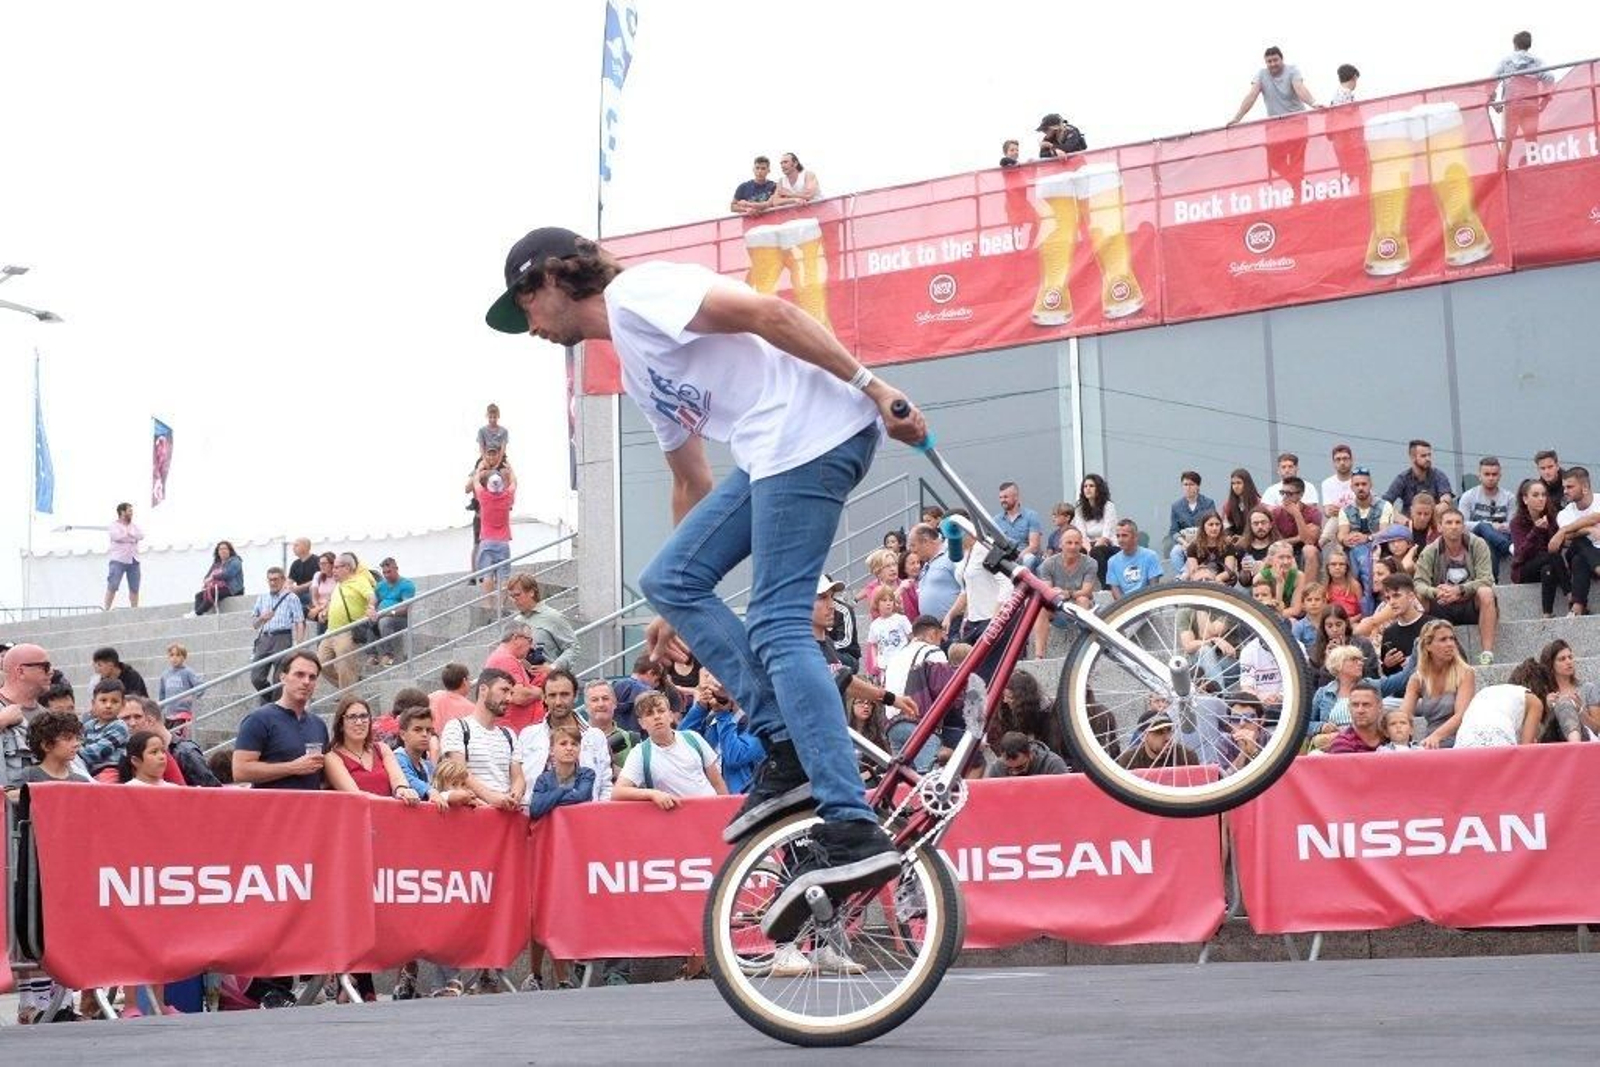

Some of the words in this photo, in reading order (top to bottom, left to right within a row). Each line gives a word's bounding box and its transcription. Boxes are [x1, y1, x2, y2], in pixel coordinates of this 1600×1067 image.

[1525, 134, 1581, 166] Bock
[1174, 196, 1224, 224] Bock
[1229, 191, 1251, 212] to
[1258, 184, 1294, 210] the
[1301, 174, 1351, 205] beat
[868, 248, 911, 274] Bock
[916, 243, 936, 264] to
[941, 237, 973, 260] the
[979, 226, 1024, 257] beat
[1297, 812, 1548, 860] NISSAN
[588, 856, 772, 894] NISS
[936, 838, 1153, 882] NISSAN
[99, 863, 313, 907] NISSAN
